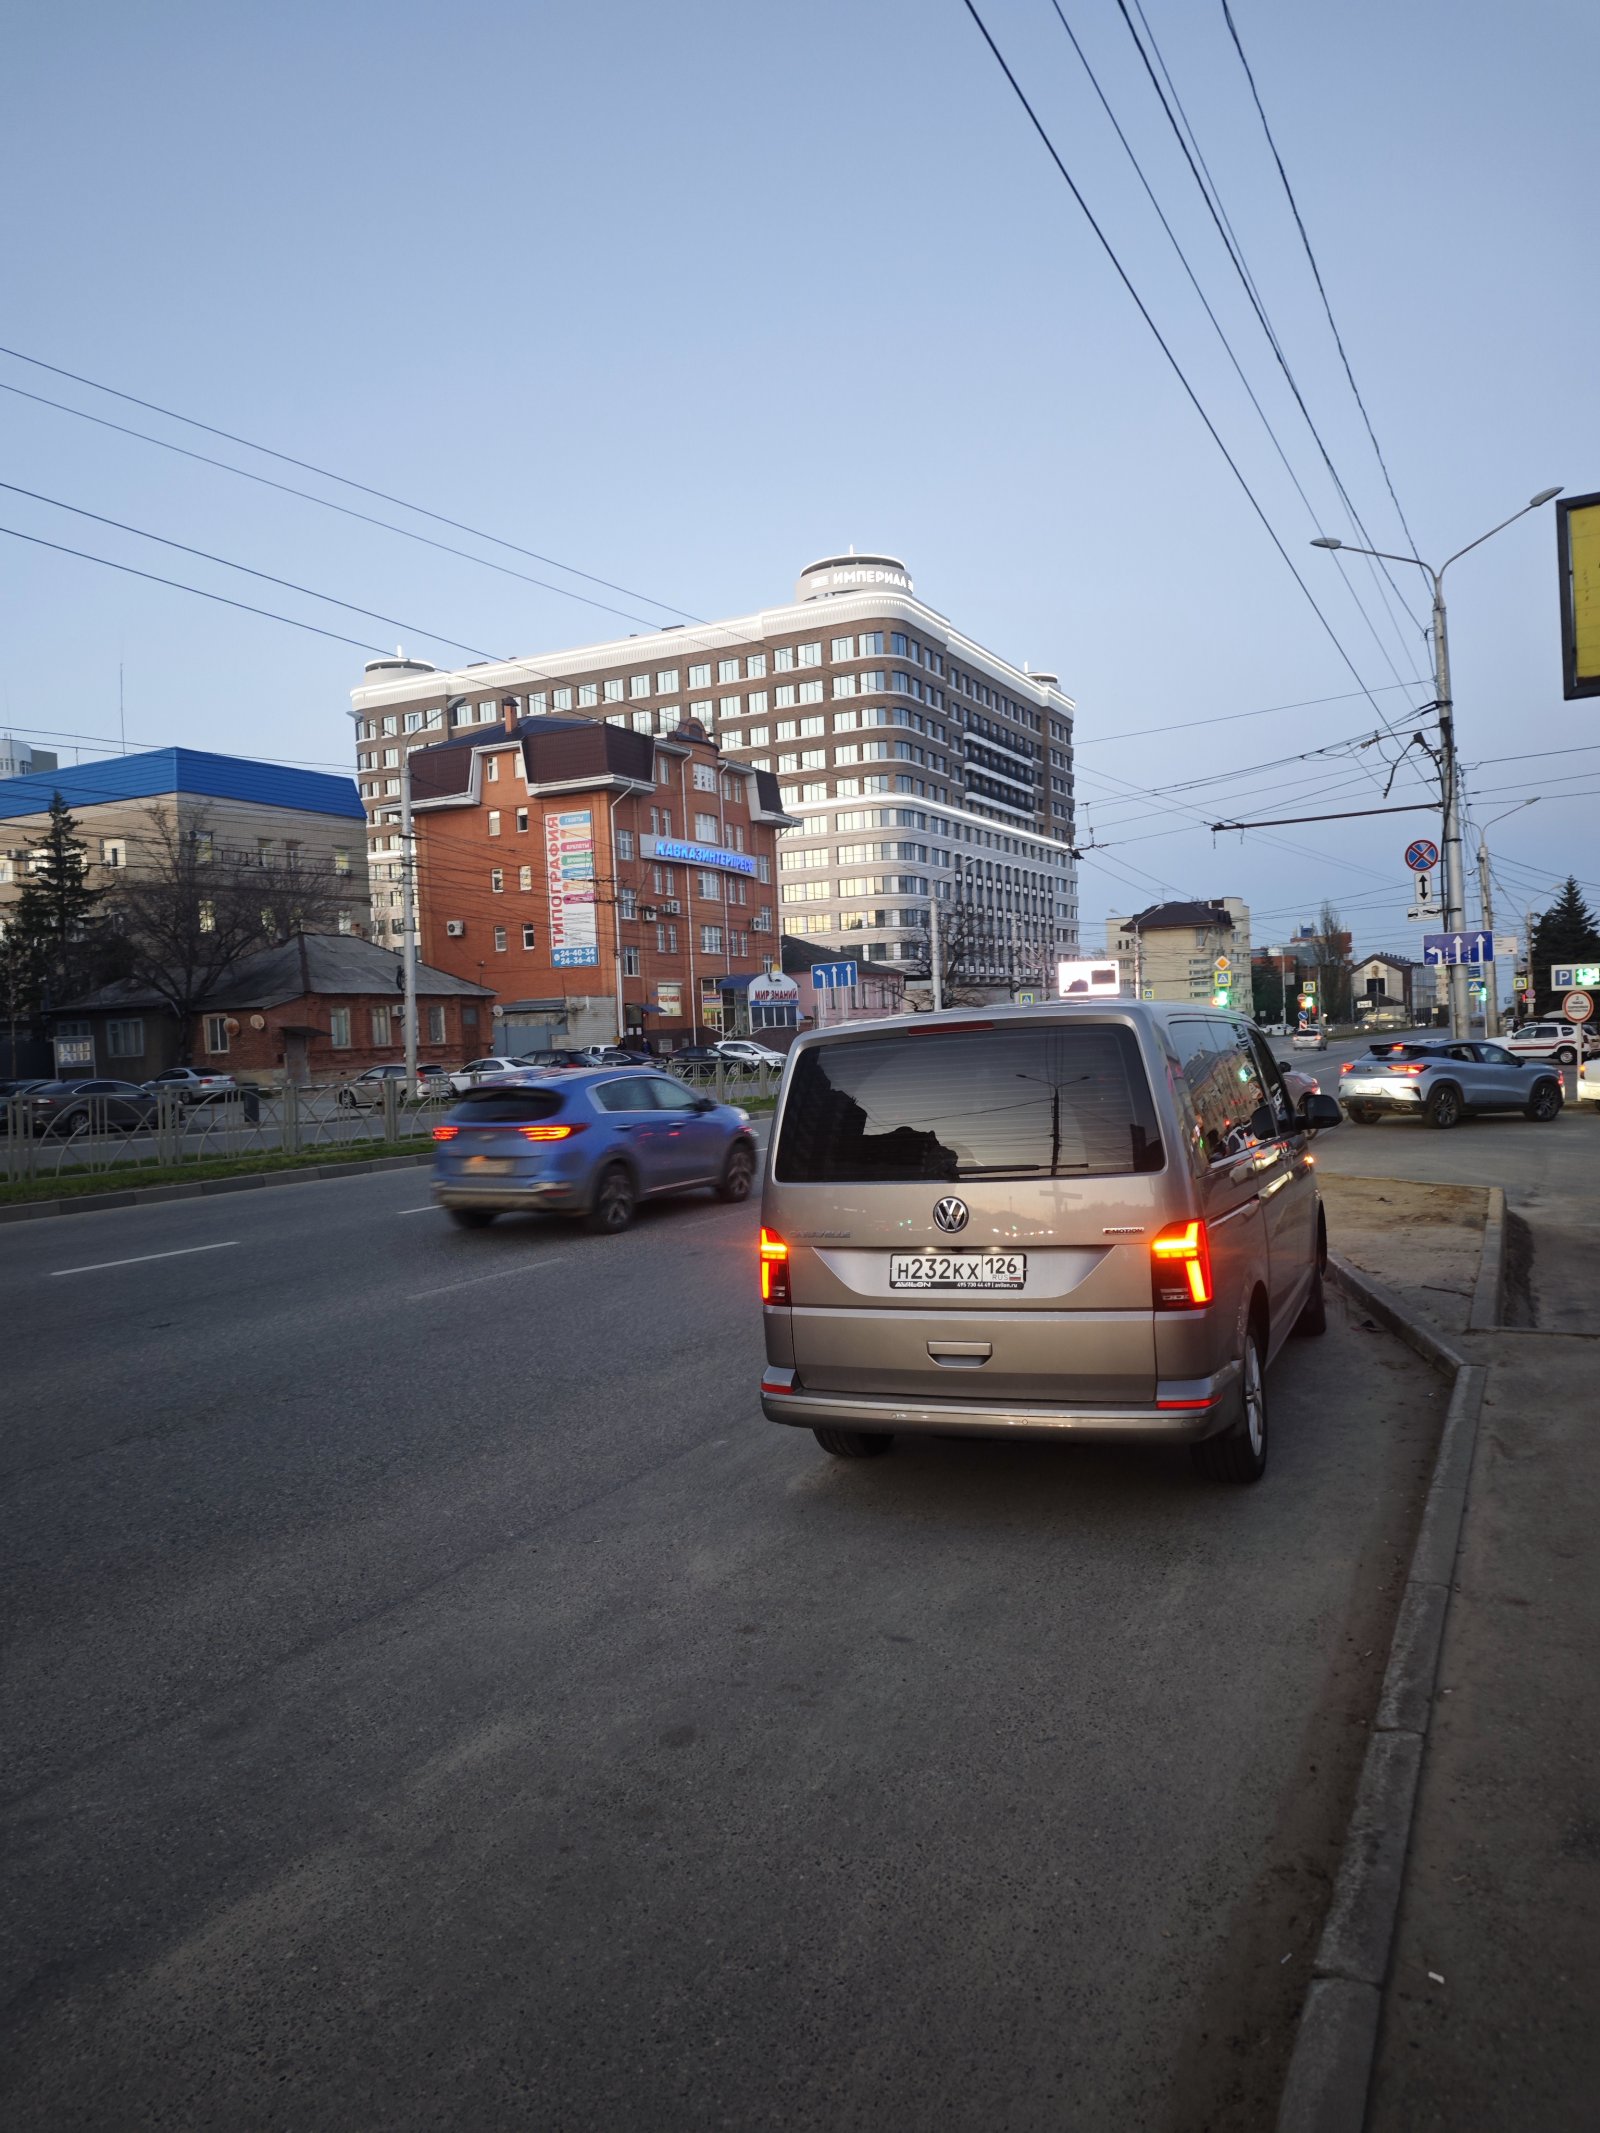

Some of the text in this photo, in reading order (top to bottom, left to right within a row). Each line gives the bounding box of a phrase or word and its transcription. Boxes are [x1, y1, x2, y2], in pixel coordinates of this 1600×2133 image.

[833, 570, 907, 588] ИМПЕРИАЛ
[547, 816, 564, 947] ТИПОГРАФИЯ
[560, 948, 595, 957] 24-40-34
[561, 956, 595, 965] 24-36-41
[1559, 971, 1570, 985] P
[755, 988, 798, 1000] МИР ЗНАНИЙ
[984, 1257, 1018, 1275] 126
